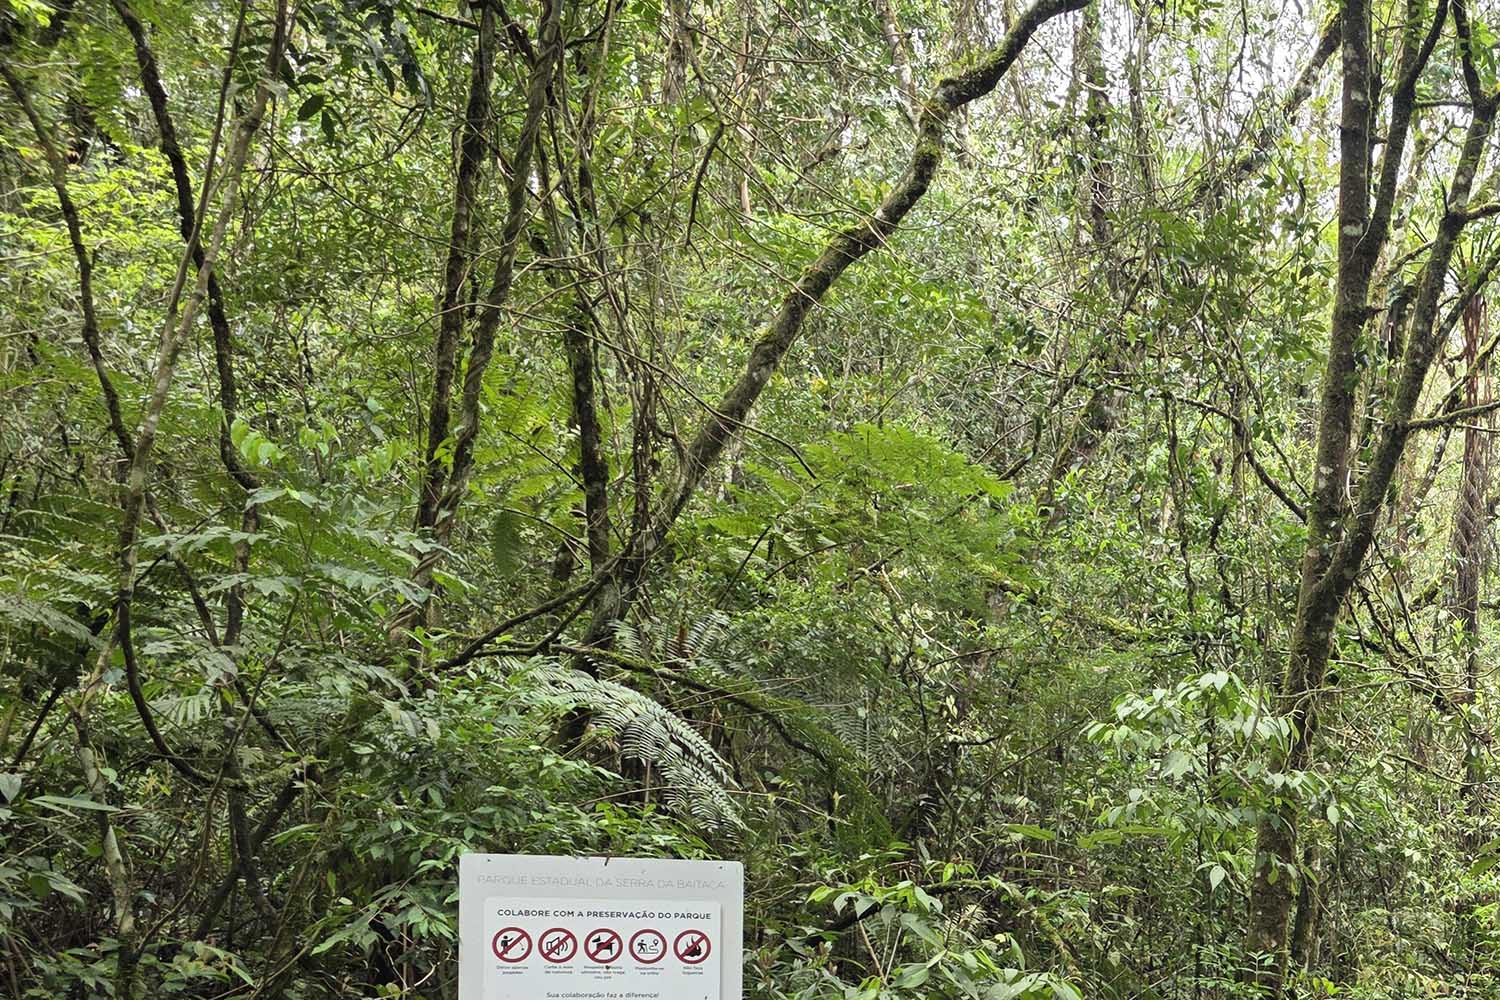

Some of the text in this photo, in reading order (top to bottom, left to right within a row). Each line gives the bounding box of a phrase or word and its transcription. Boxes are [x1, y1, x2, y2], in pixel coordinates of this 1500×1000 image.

[477, 875, 528, 885] PARQUE
[531, 876, 593, 887] ESTADUAL
[596, 878, 613, 888] DA
[616, 878, 655, 888] SERRA
[657, 880, 674, 889] DA
[497, 909, 550, 917] COLABORE
[587, 910, 655, 919] PRESERVAÇÃO
